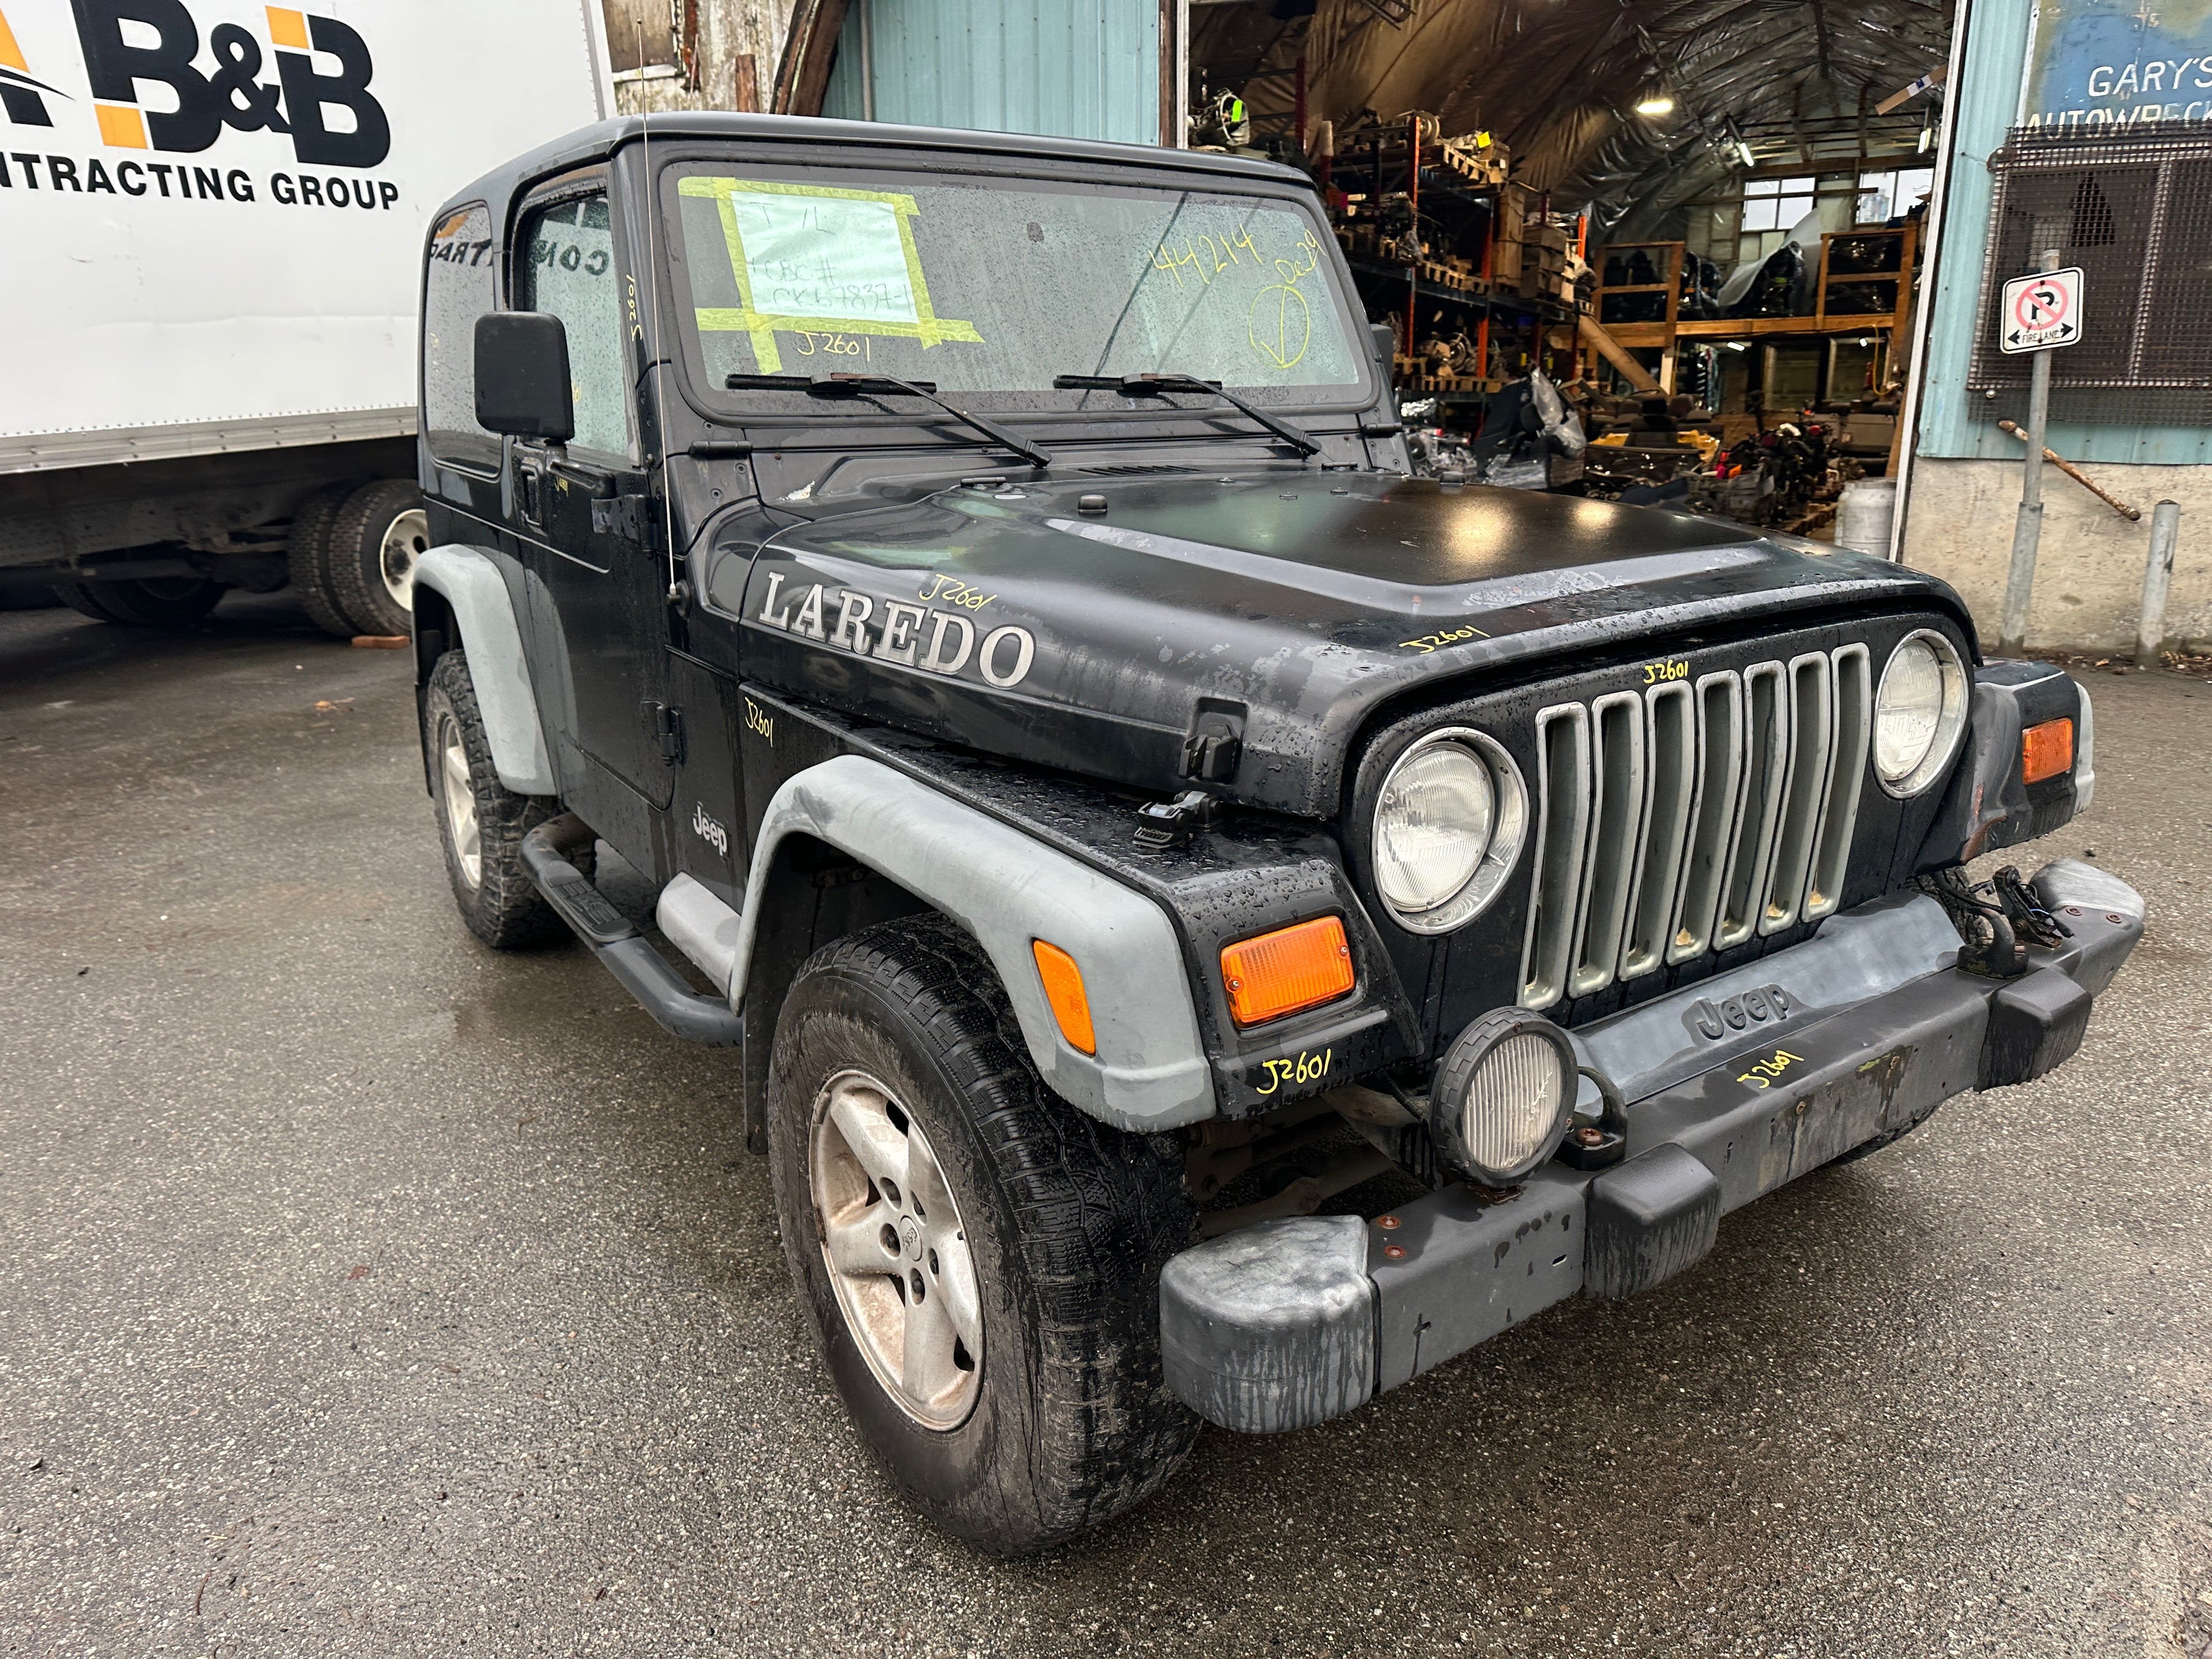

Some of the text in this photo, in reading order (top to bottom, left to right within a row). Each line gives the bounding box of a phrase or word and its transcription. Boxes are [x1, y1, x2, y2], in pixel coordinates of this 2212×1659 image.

[0, 151, 399, 210] TRACTING GROUP
[1149, 224, 1264, 287] 44214
[795, 330, 870, 362] J2601
[2022, 333, 2038, 344] FIRE
[919, 573, 998, 611] J2601
[758, 571, 1036, 690] LAREDO
[1399, 625, 1491, 654] J2601
[1643, 661, 1688, 684] J2601
[744, 696, 774, 748] J2601
[693, 805, 727, 857] Jeep
[1695, 983, 1790, 1040] Jeep
[1256, 1048, 1331, 1094] J2601
[1736, 1050, 1804, 1089] J2601
